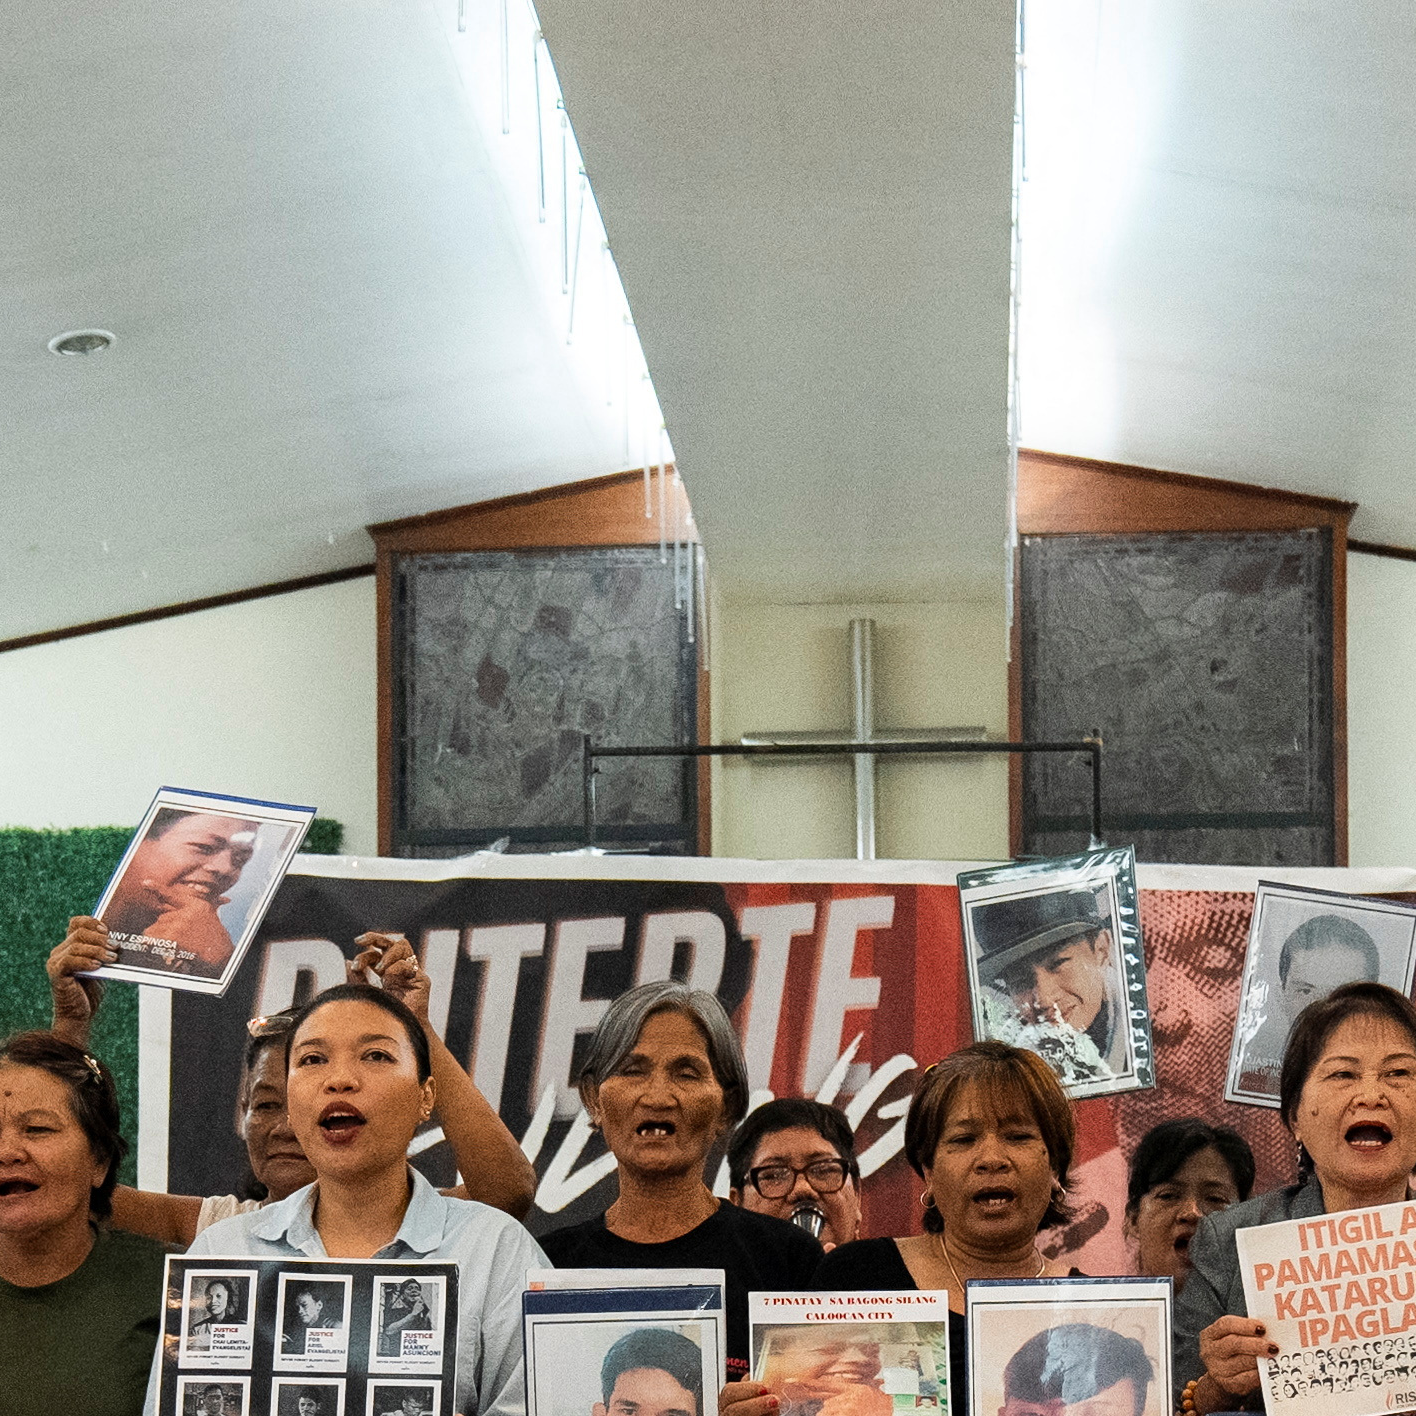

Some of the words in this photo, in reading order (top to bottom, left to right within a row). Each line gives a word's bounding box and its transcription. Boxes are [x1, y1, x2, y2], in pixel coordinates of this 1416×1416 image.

[130, 935, 177, 948] ESPINOSA
[1298, 1205, 1393, 1250] ITIGIL
[896, 1296, 936, 1304] SILANG
[806, 1312, 864, 1320] CALOOCAN
